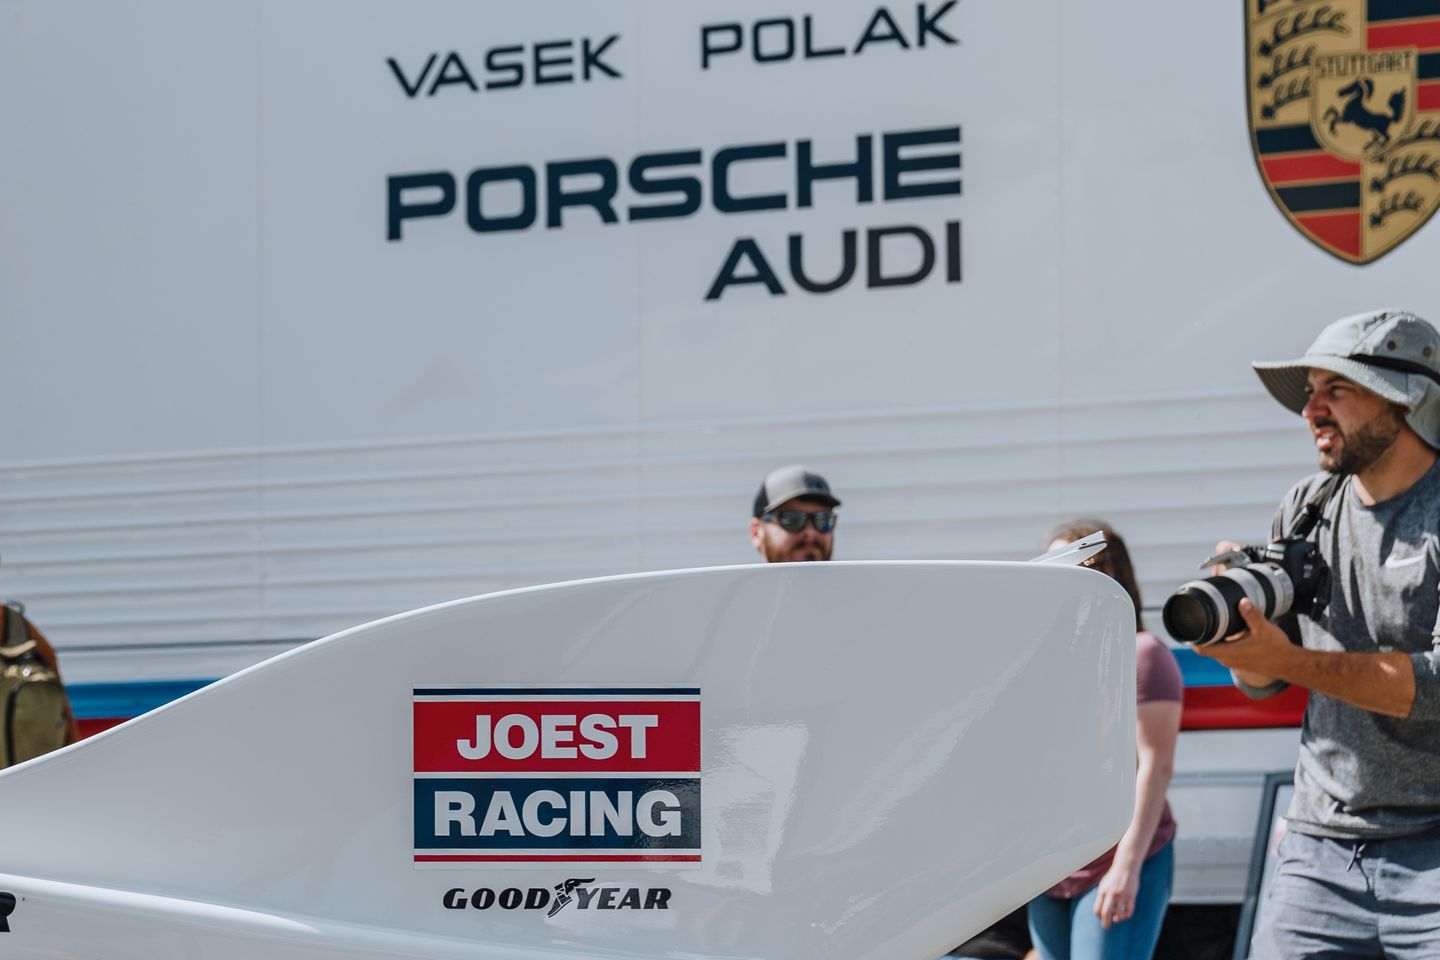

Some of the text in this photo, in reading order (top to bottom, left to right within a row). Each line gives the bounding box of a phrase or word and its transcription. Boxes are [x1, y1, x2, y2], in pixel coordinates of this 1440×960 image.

[386, 0, 961, 98] VASEK POLAK
[1314, 49, 1412, 78] STUTTGART
[386, 124, 962, 241] PORSCHE
[703, 220, 962, 302] AUDI
[456, 713, 659, 760] JOEST
[434, 789, 682, 838] RACING
